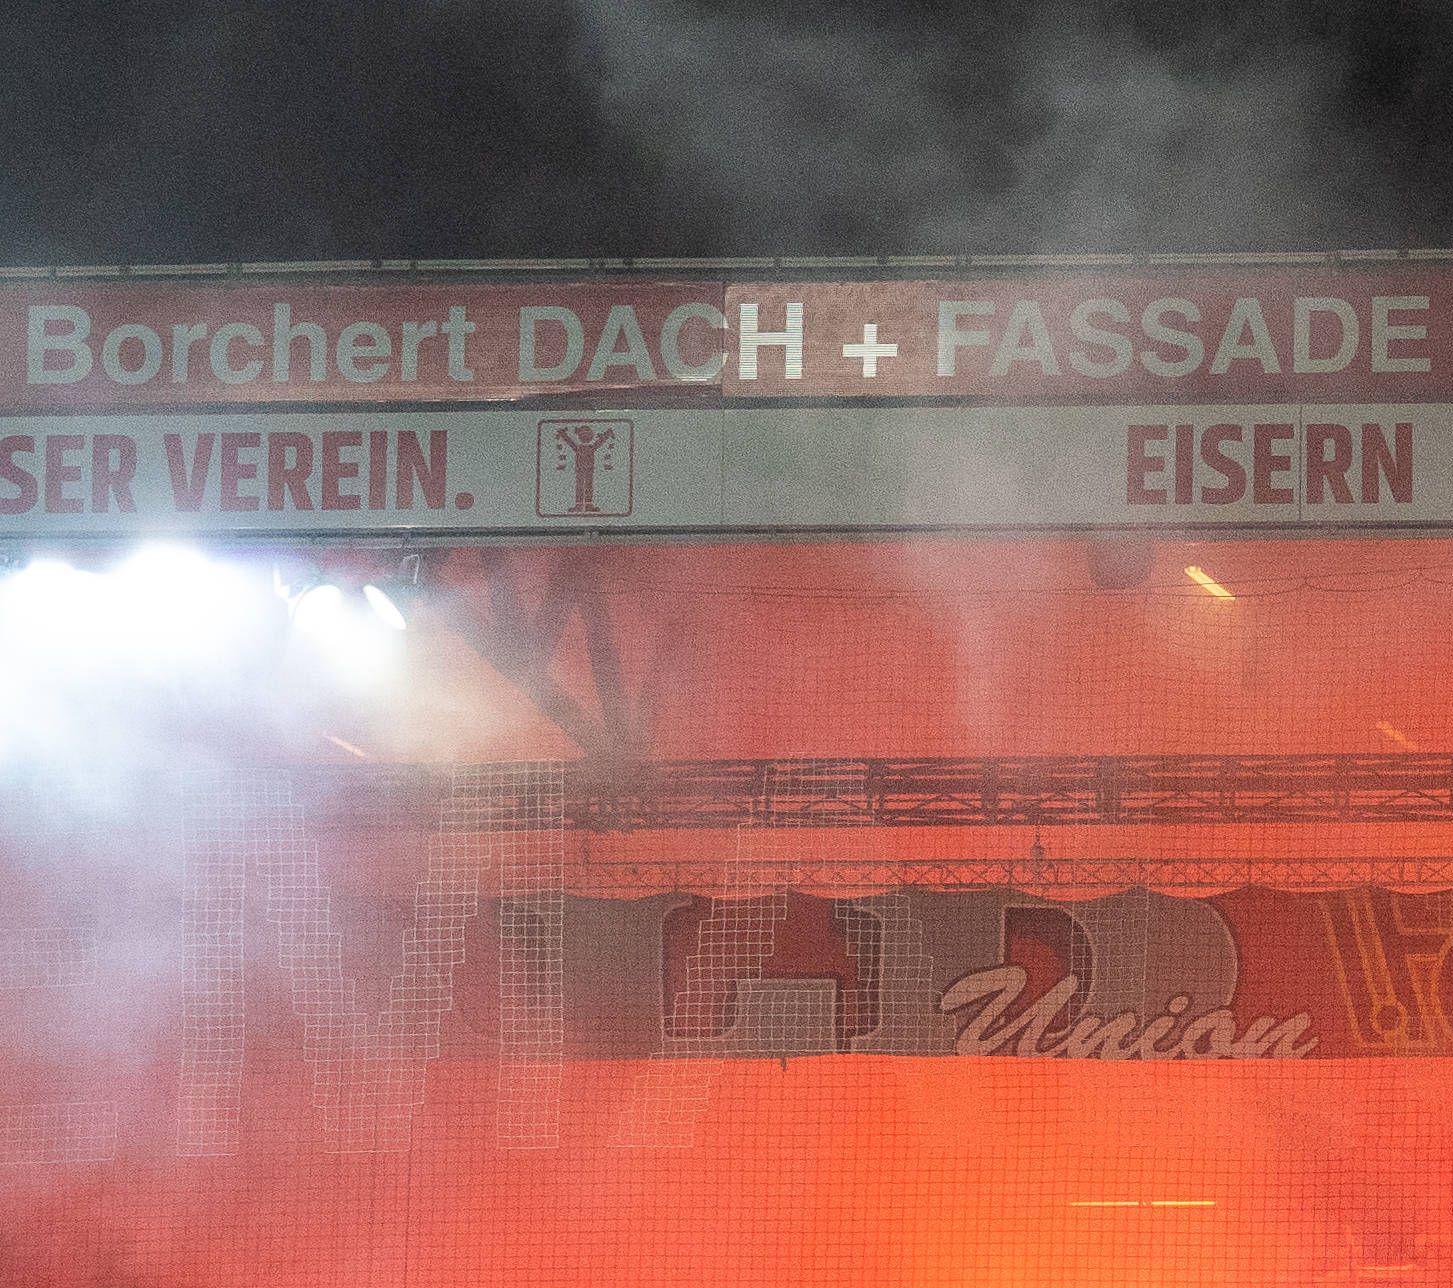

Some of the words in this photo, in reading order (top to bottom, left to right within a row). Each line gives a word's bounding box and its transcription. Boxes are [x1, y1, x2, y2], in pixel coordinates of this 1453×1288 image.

[27, 302, 475, 386] Borchert
[521, 302, 803, 384] DACH
[937, 295, 1432, 379] FASSADE
[164, 430, 475, 512] VEREIN.
[1126, 424, 1414, 506] EISERN
[941, 965, 1319, 1059] Union
